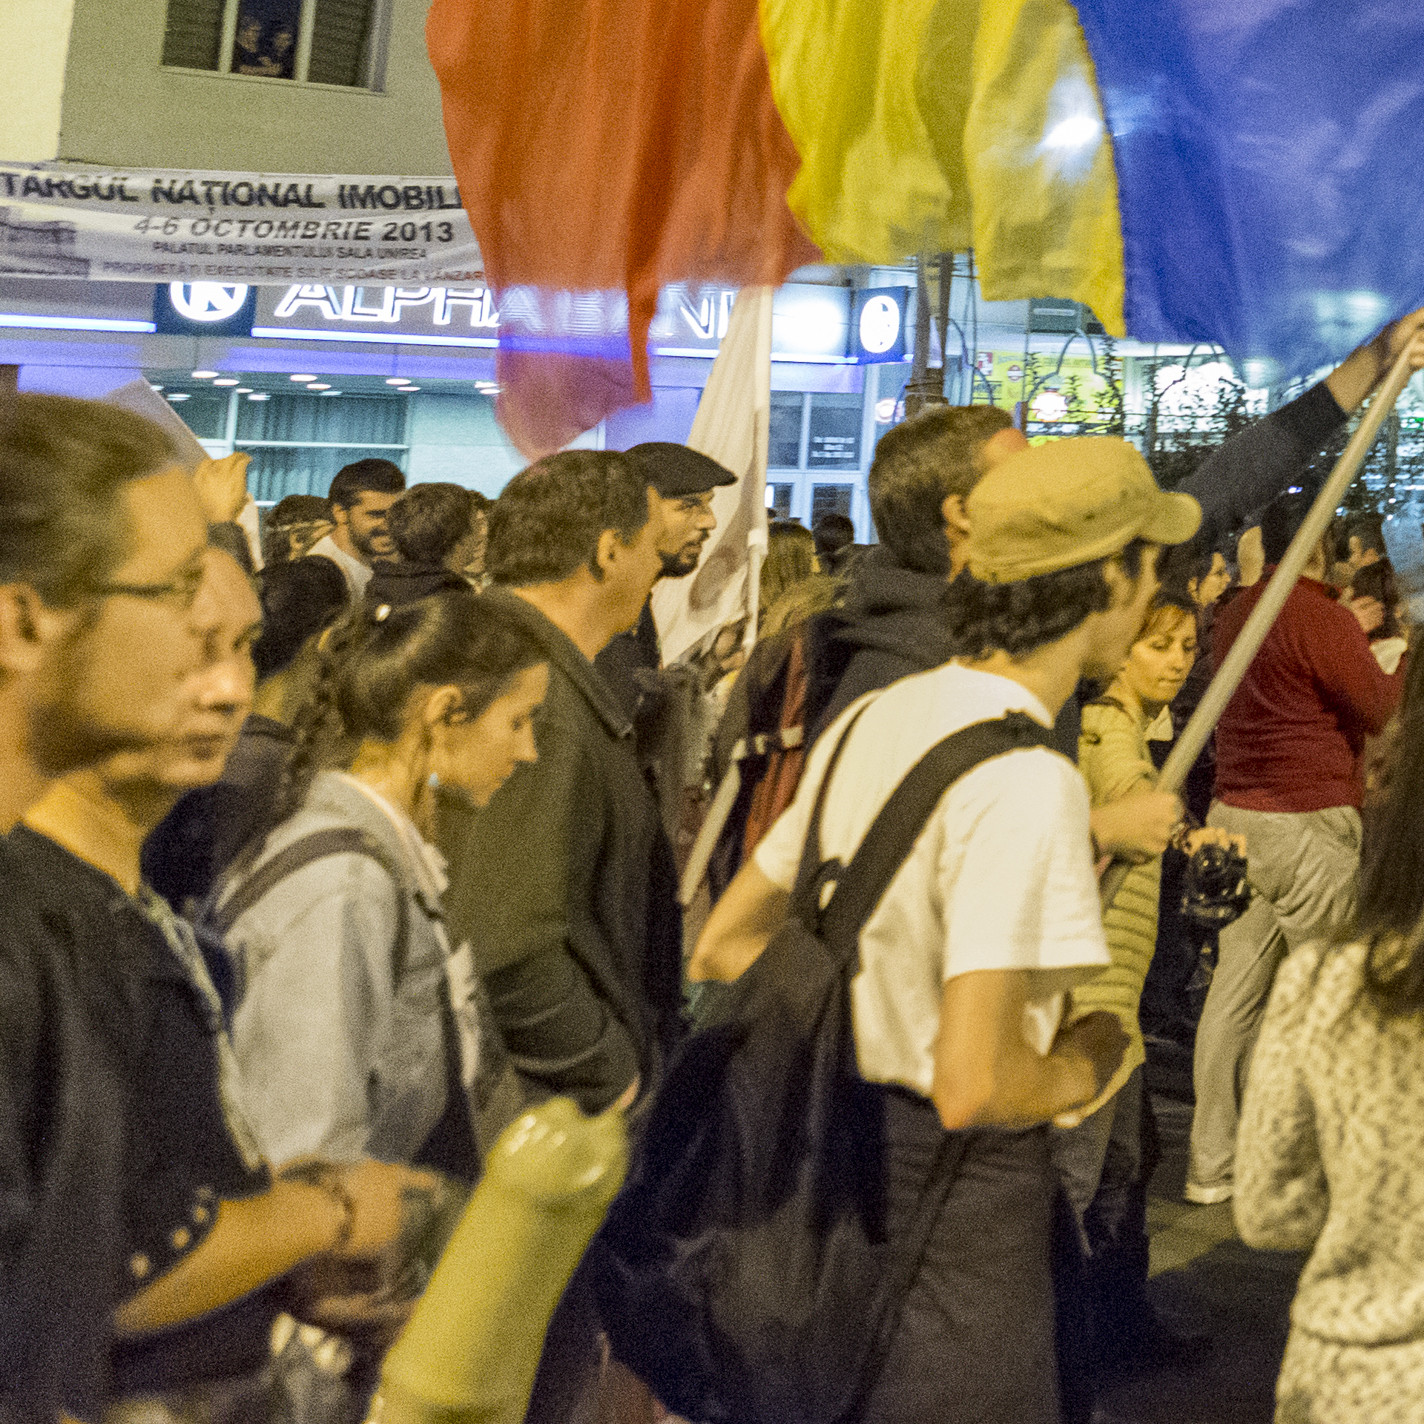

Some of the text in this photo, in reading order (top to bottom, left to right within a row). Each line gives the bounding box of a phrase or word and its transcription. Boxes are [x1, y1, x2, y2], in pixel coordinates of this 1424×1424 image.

[133, 216, 455, 243] 4-6 OCTOMBRIE 2013
[337, 246, 373, 259] SALA
[274, 283, 544, 334] ALPHA
